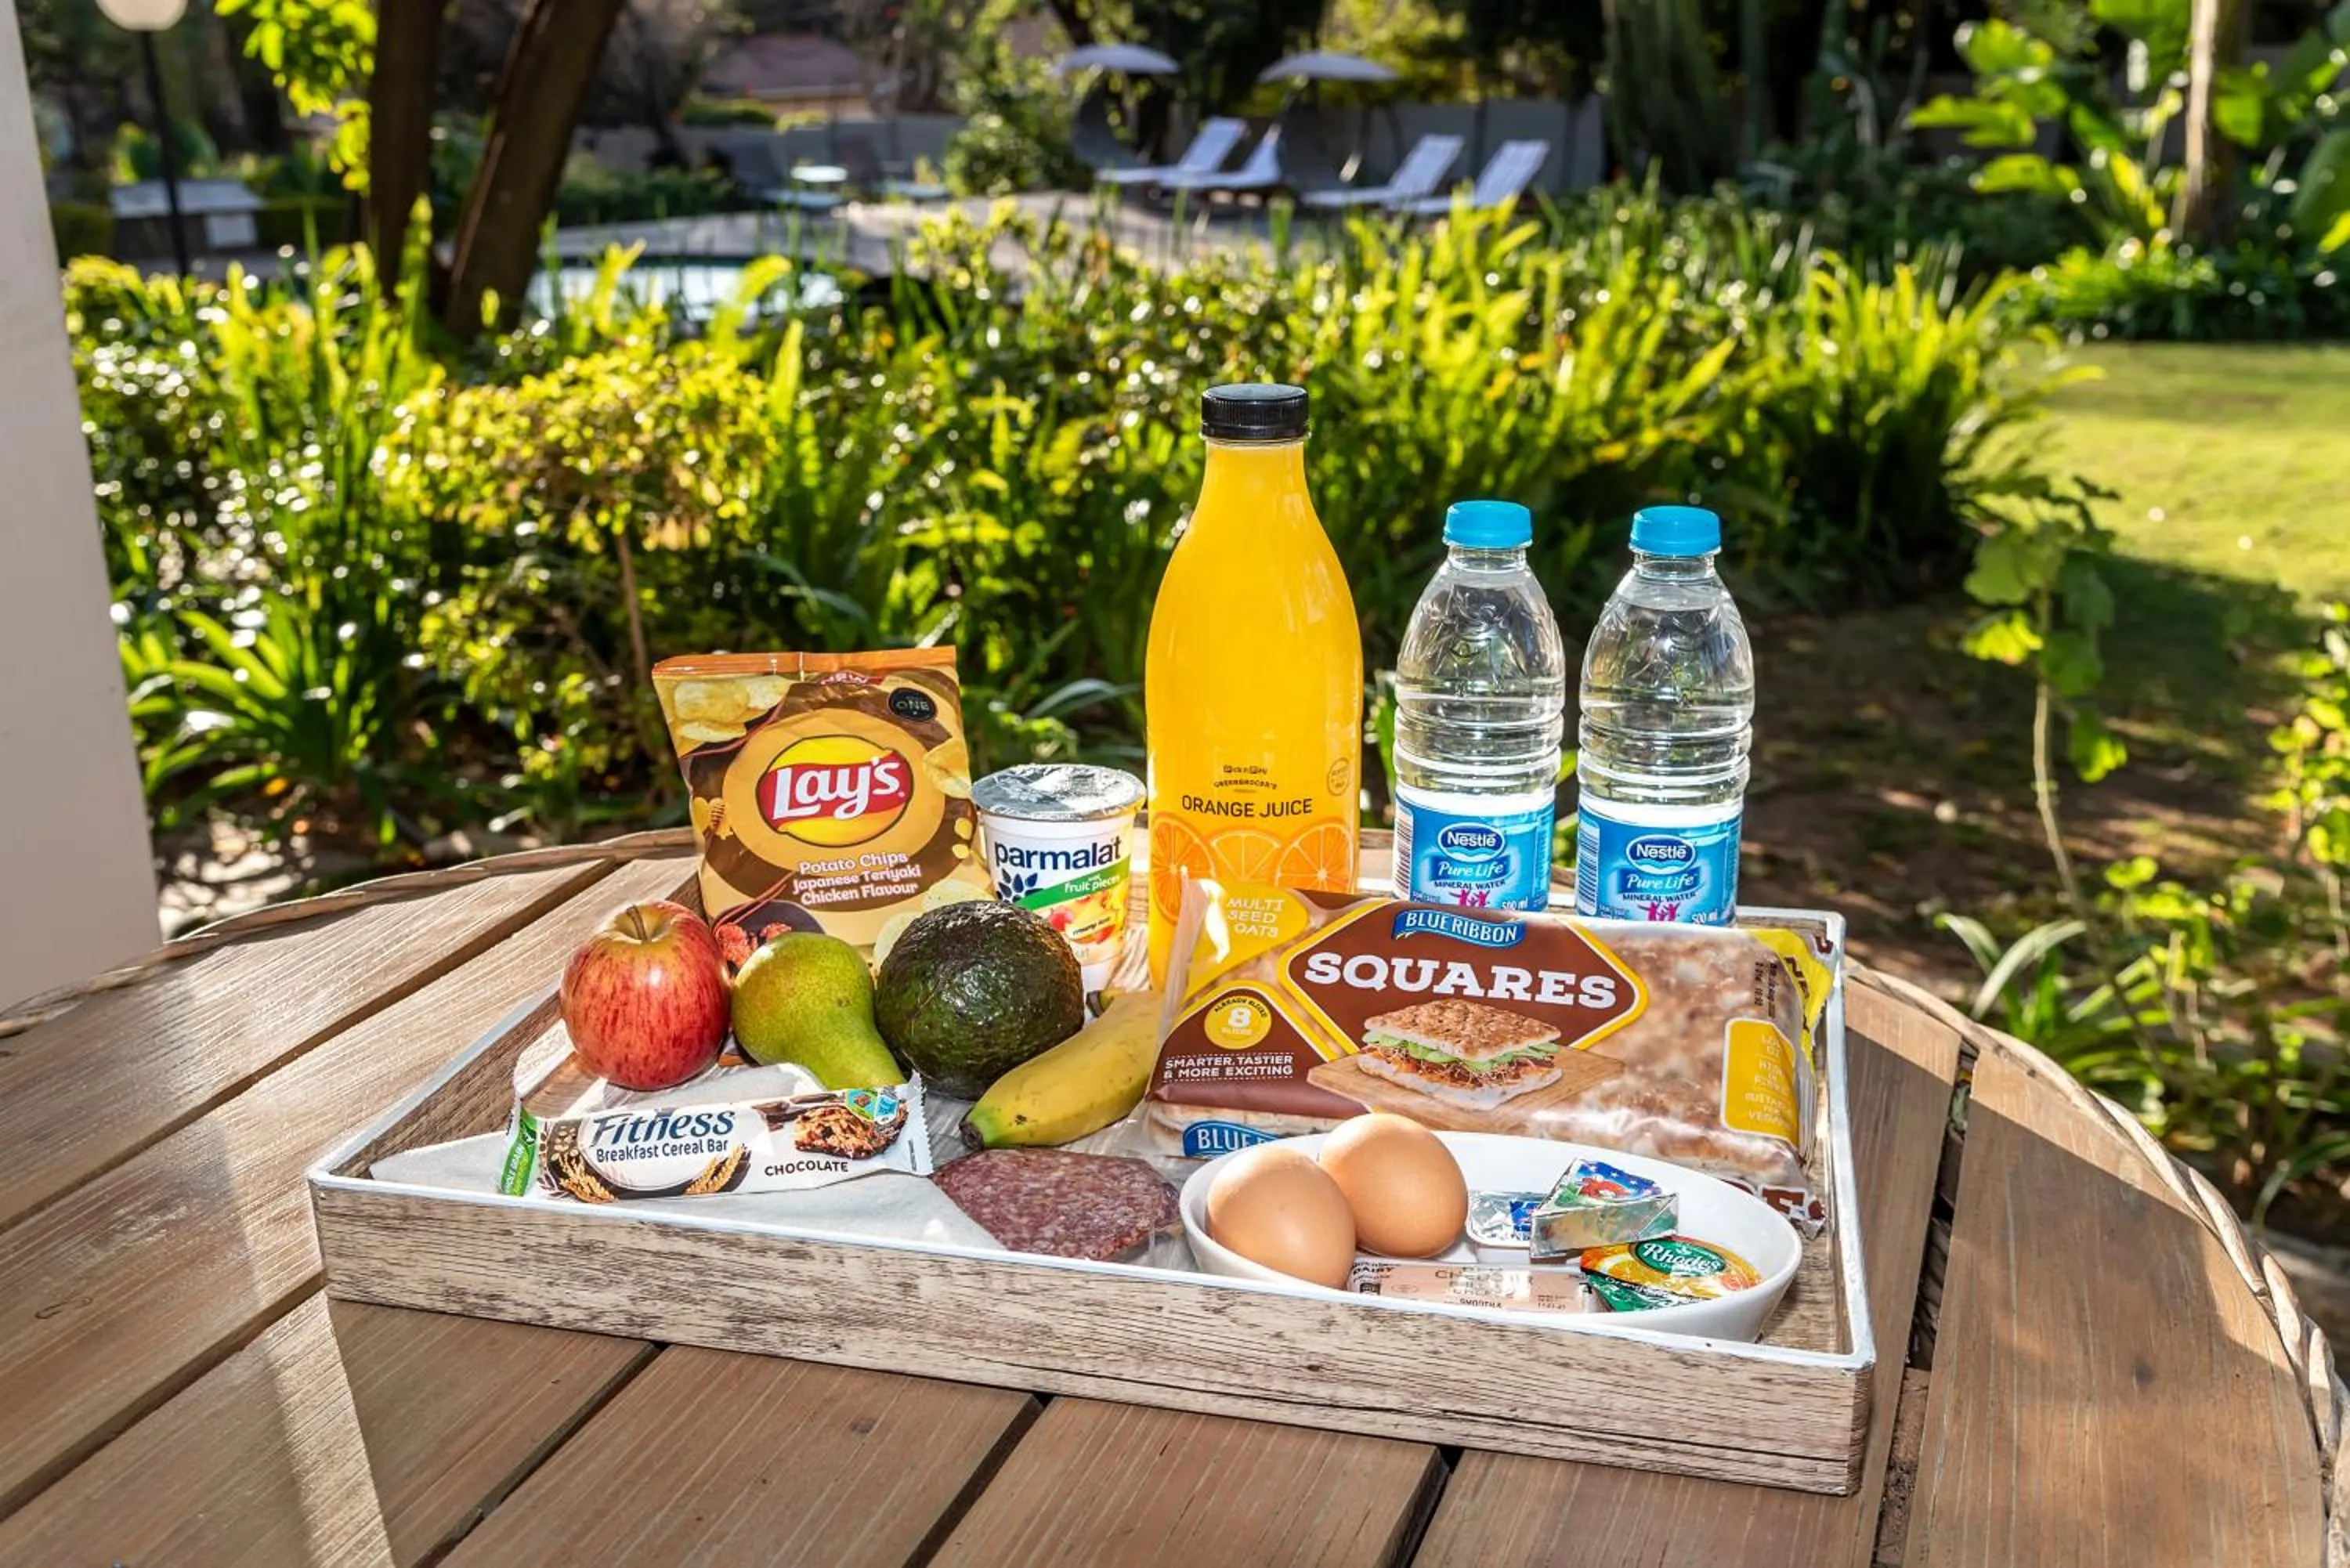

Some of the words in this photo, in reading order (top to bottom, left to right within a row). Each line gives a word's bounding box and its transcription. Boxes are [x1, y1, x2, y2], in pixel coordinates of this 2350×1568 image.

[772, 755, 901, 821] Lay's
[1181, 794, 1255, 818] ORANGE
[1259, 797, 1314, 818] JUICE
[799, 860, 856, 875] Potato
[859, 851, 909, 868] Chips
[994, 836, 1122, 870] parmalat
[792, 874, 860, 895] Japanese
[861, 865, 922, 882] Teriyaki
[1438, 861, 1473, 877] Pure
[1475, 861, 1505, 878] Life
[1064, 881, 1090, 894] fruit
[1434, 880, 1473, 890] MINERAL
[1475, 879, 1507, 890] WATER
[1626, 873, 1663, 889] Pure
[1665, 873, 1695, 890] Life
[801, 888, 859, 905] Chicken
[860, 882, 920, 899] Flavour
[1622, 893, 1662, 902] MINERAL
[1665, 891, 1697, 902] WATER
[1227, 898, 1285, 913] MULTI
[1227, 909, 1277, 923] SEED
[1405, 912, 1450, 932] BLUE
[1451, 920, 1518, 943] RIBBON
[1303, 951, 1618, 1010] SQUARES
[1227, 1006, 1252, 1028] 8
[1177, 1068, 1220, 1078] MORE
[1225, 1064, 1294, 1077] EXCITING
[1237, 1055, 1294, 1066] TASTIER
[589, 1110, 736, 1149] Fitness
[1197, 1129, 1253, 1151] BLUE
[596, 1144, 659, 1163] Breakfast
[662, 1140, 704, 1157] Cereal
[707, 1138, 728, 1152] Bar
[764, 1160, 848, 1177] CHOCOLATE
[1643, 1241, 1721, 1270] Rhodes
